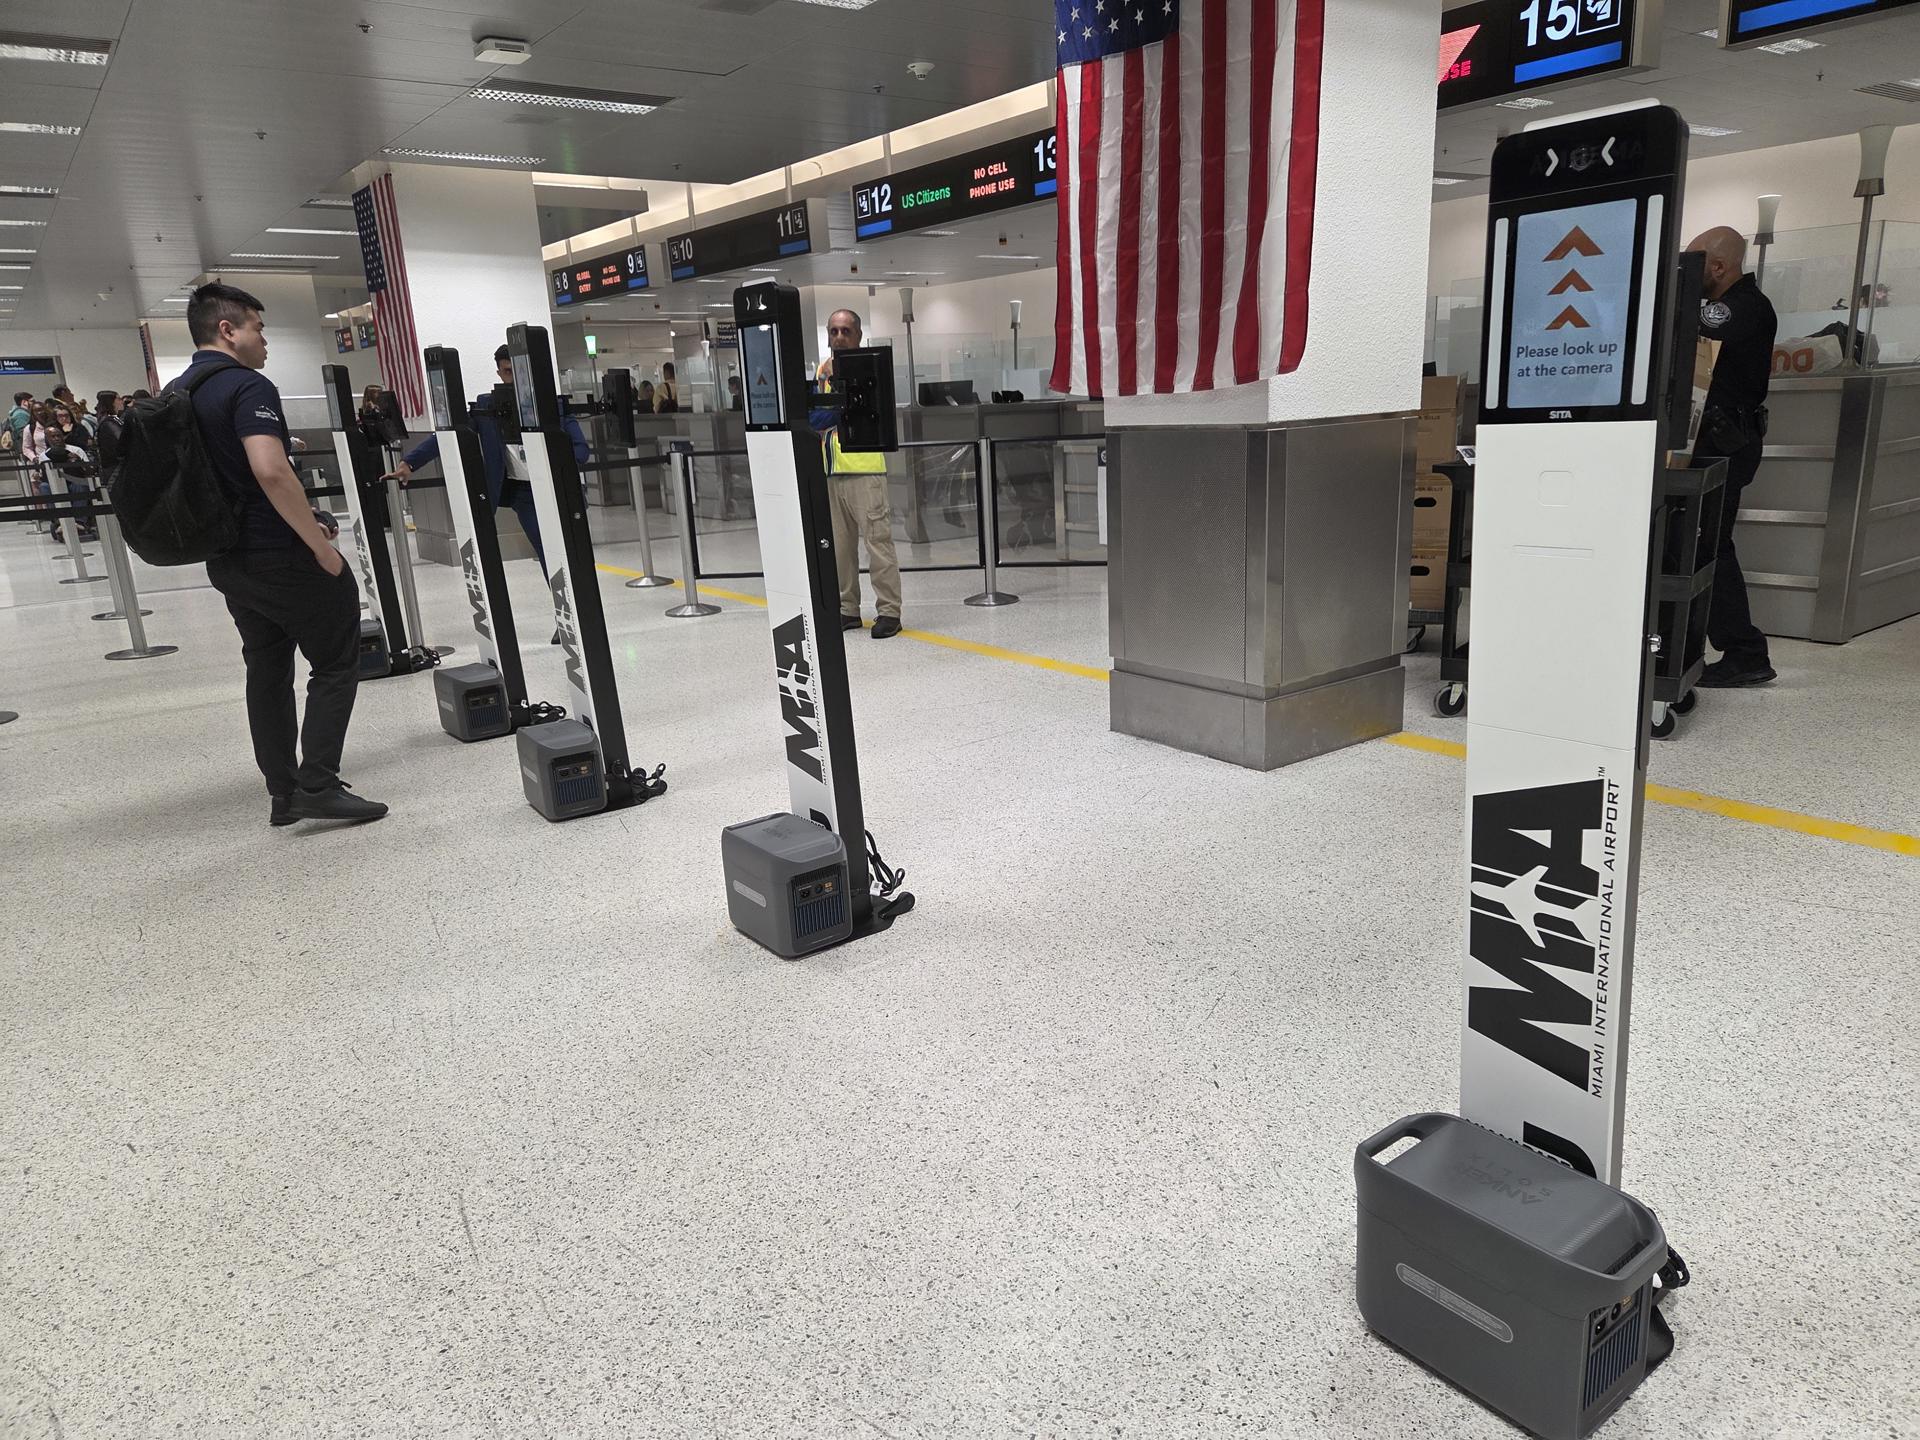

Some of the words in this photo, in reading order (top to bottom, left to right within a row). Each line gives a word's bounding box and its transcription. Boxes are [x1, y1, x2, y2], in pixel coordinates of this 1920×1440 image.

[1519, 0, 1577, 47] 15
[1034, 135, 1057, 172] 13
[974, 167, 986, 180] NO
[987, 161, 1008, 176] CELL
[871, 183, 893, 214] 12
[901, 193, 915, 209] US
[916, 186, 951, 205] Citizens
[969, 182, 997, 199] PHONE
[998, 177, 1015, 191] USE
[777, 211, 792, 237] 11
[680, 238, 693, 261] 10
[627, 253, 635, 274] 9
[562, 271, 569, 290] 8
[1516, 345, 1559, 358] Please
[1562, 341, 1595, 356] look
[1598, 343, 1618, 356] up
[1517, 366, 1531, 378] at
[1534, 364, 1557, 377] the
[1561, 363, 1613, 376] camera
[1549, 410, 1573, 419] SITA
[773, 614, 824, 784] MIA
[1603, 779, 1620, 872] AIRPORT
[1468, 779, 1605, 1093] MIA
[1594, 878, 1615, 1037] INTERNATIONAL
[1591, 1043, 1605, 1099] MIAMI
